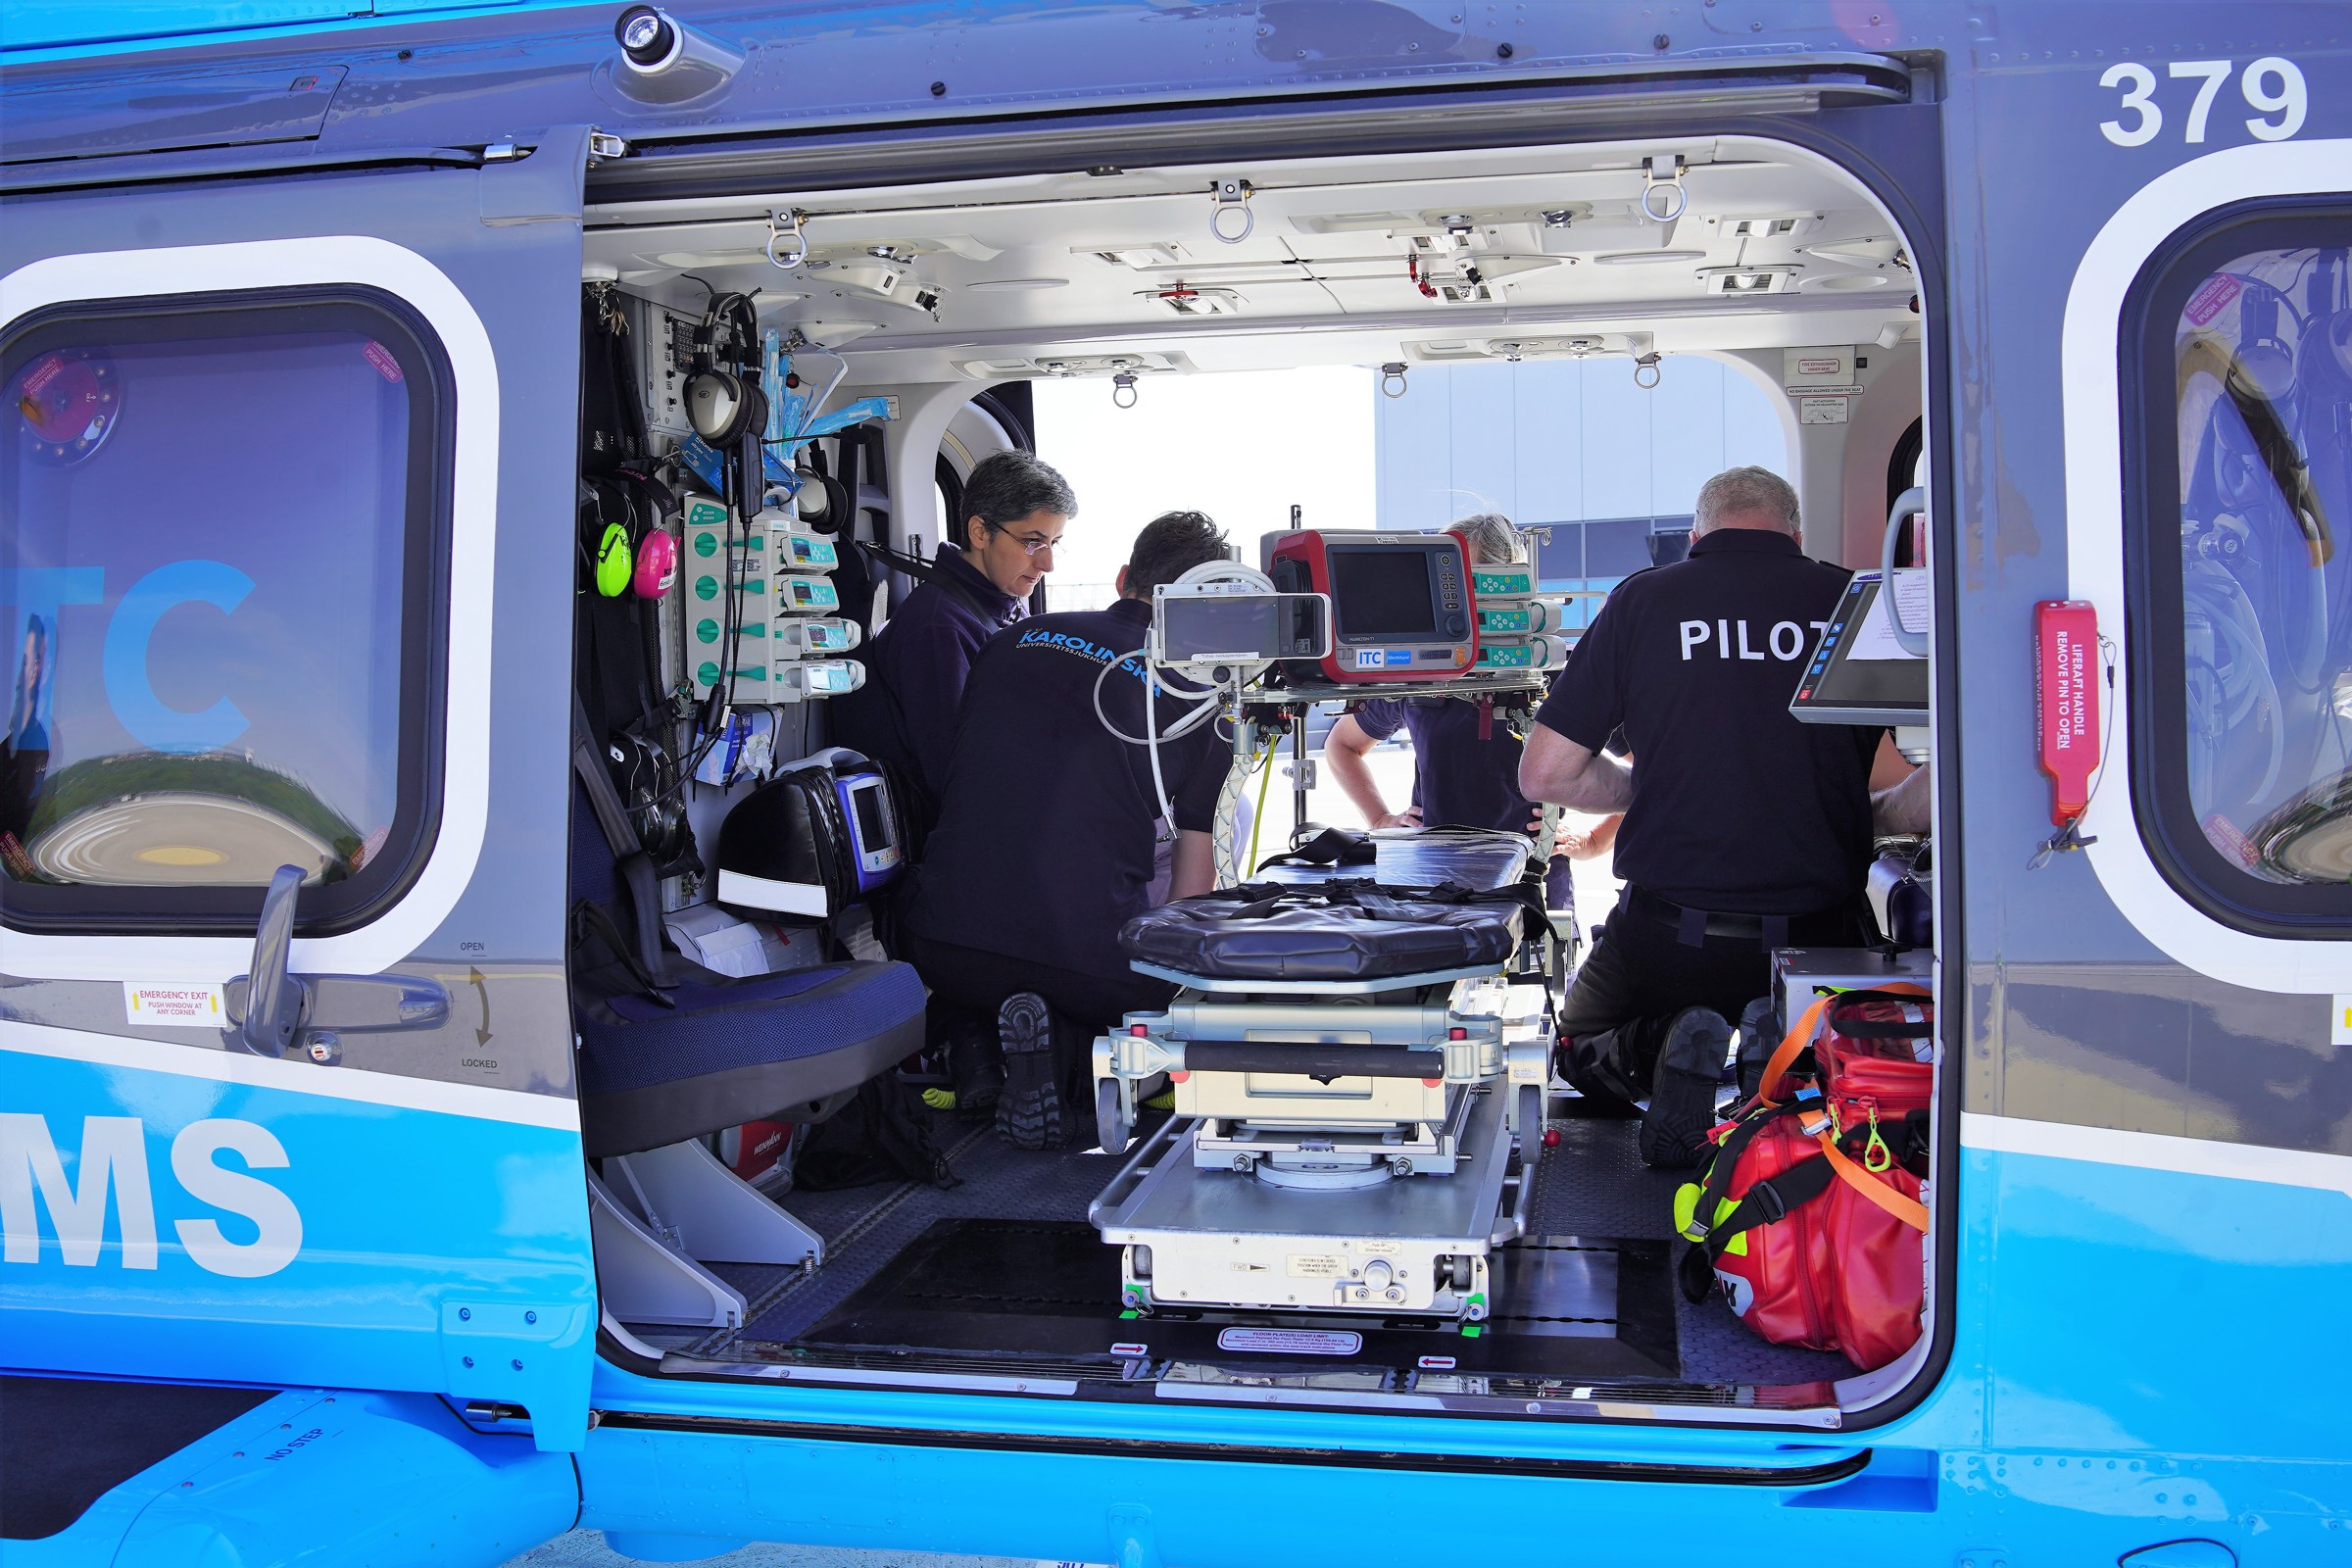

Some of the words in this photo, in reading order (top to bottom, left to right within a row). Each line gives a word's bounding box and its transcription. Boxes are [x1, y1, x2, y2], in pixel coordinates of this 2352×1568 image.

[2099, 57, 2308, 147] 379
[2186, 274, 2228, 315] EMERGENCY
[2197, 303, 2218, 322] PUSH
[2217, 283, 2238, 304] HERE
[24, 358, 57, 389] EMERGENCY
[366, 348, 381, 365] PUSH
[380, 363, 398, 380] HERE
[29, 379, 45, 395] PUSH
[1016, 641, 1117, 669] UNIVERSITETSSJUKHUST
[1359, 652, 1381, 664] ITC
[2056, 631, 2069, 677] REMOVE
[2072, 644, 2083, 689] LIFERAFT
[2058, 679, 2069, 698] PIN
[2059, 700, 2070, 715] TO
[2073, 691, 2084, 736] HANDLE
[2059, 717, 2070, 749] OPEN
[5, 833, 33, 870] EMERGENCY
[2215, 816, 2259, 858] EMERGENCY
[460, 942, 485, 951] OPEN
[139, 990, 189, 1000] EMERGENCY
[191, 991, 208, 1000] EXIT
[462, 1058, 498, 1068] LOCKED
[263, 1448, 293, 1461] NO
[286, 1428, 324, 1448] STEP
